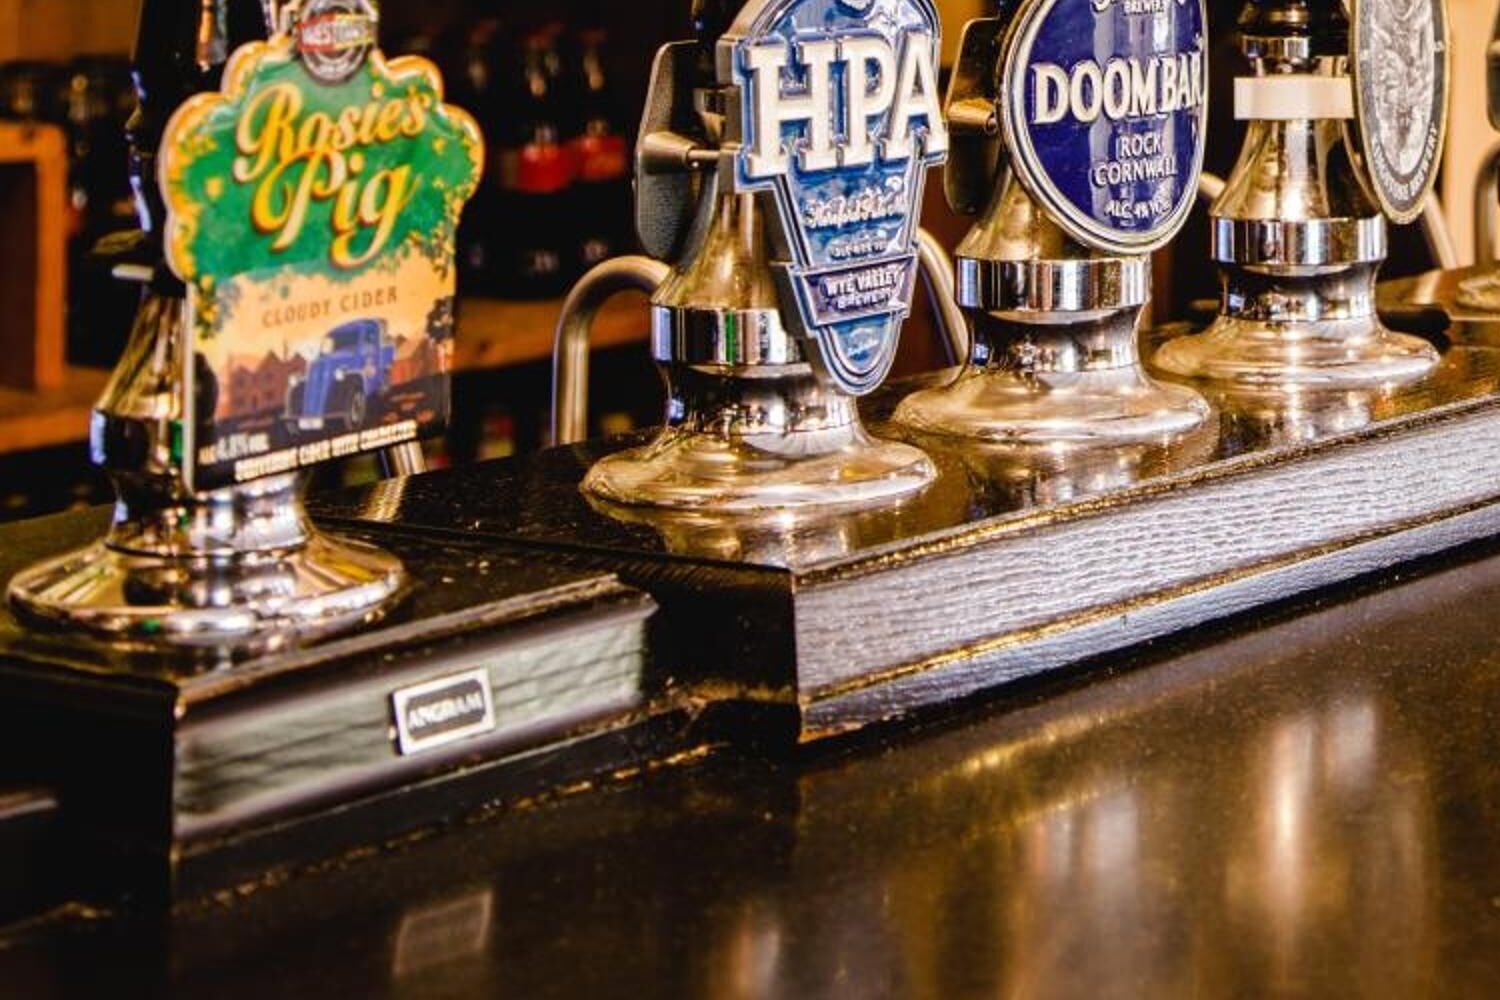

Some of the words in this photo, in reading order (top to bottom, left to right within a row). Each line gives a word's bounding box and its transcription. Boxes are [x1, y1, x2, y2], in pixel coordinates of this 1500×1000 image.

[746, 30, 948, 177] HPA
[1030, 56, 1162, 125] DOOM
[1161, 51, 1205, 111] BAR
[233, 81, 431, 183] Rosie's
[1120, 131, 1162, 158] ROCK
[1094, 153, 1178, 186] CORNWALL
[252, 152, 423, 270] Pig
[261, 298, 332, 328] CLOUDY
[340, 287, 398, 312] CIDER
[826, 274, 852, 298] WYE
